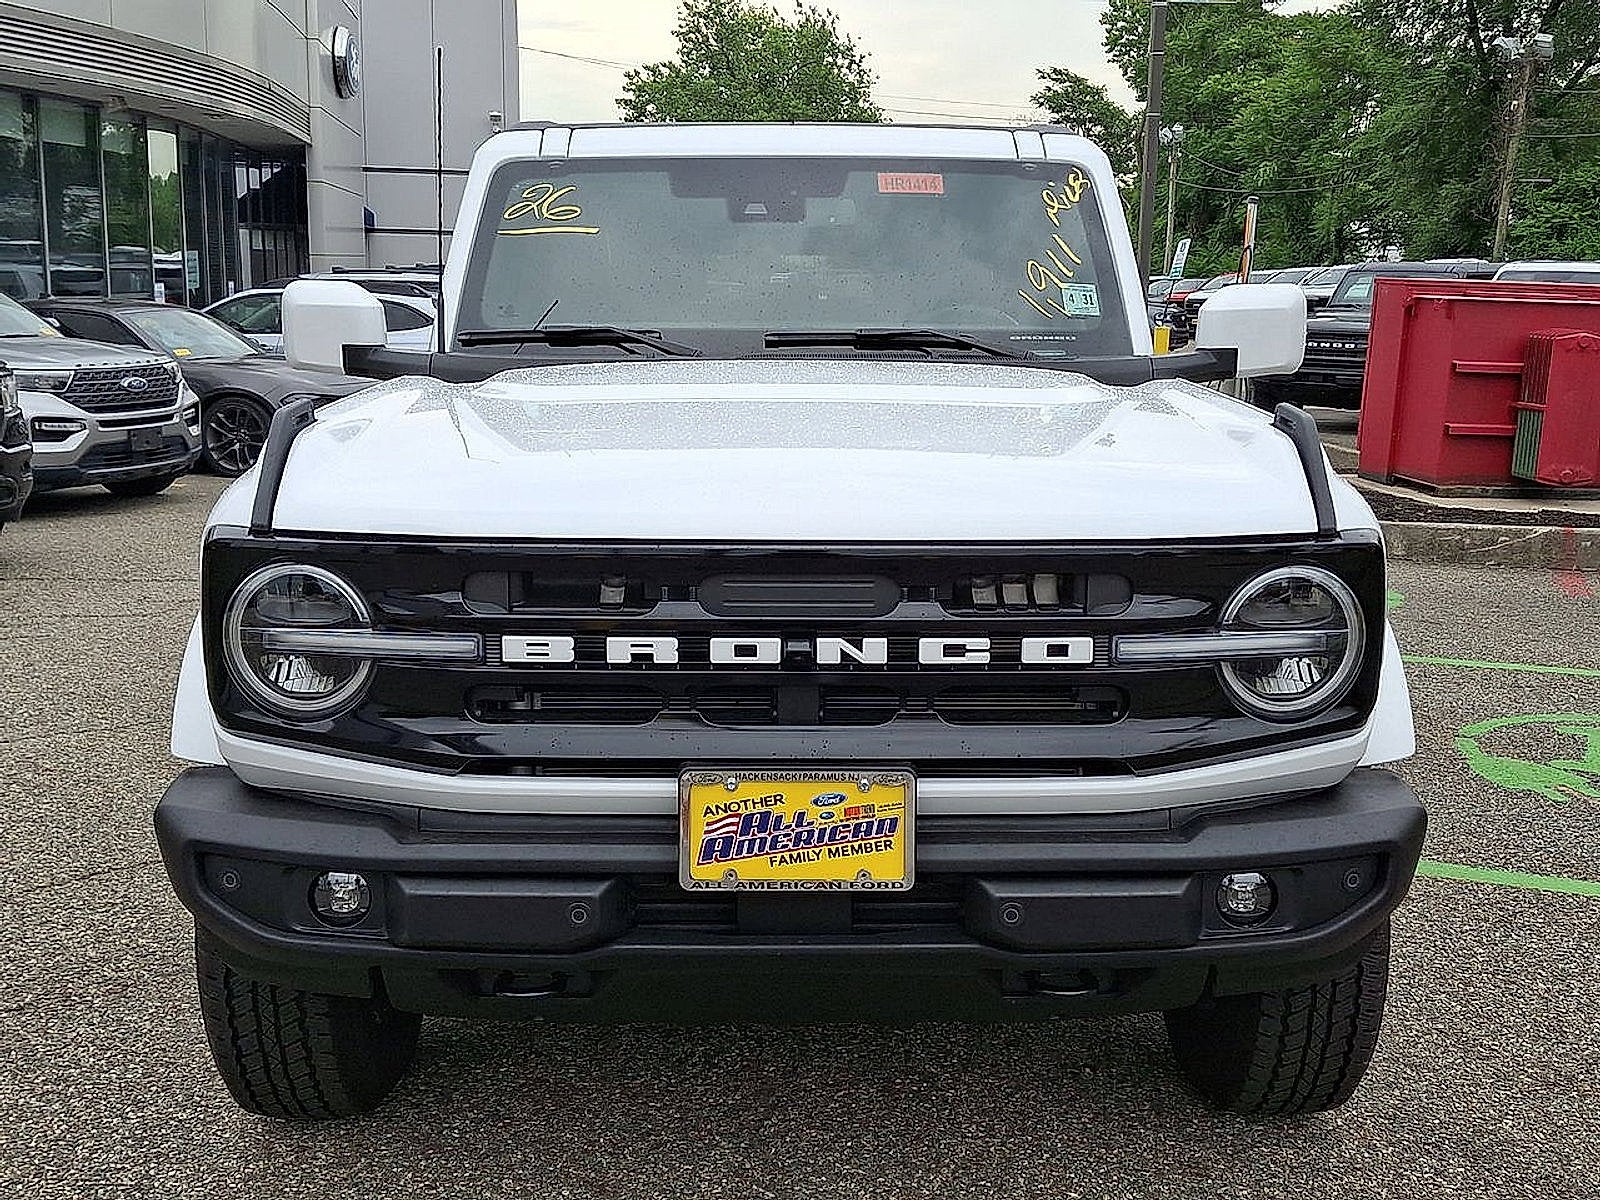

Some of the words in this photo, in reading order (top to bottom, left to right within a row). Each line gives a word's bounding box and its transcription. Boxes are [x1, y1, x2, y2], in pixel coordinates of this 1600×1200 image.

[503, 182, 582, 222] 26
[1082, 293, 1094, 305] 31
[502, 635, 1094, 664] BRONCO
[848, 772, 861, 781] NJ
[702, 793, 786, 818] ANOTHER
[768, 848, 823, 868] FAMILY
[827, 839, 894, 859] MEMBER
[690, 881, 728, 890] ALL
[734, 881, 841, 890] AMERICAN
[849, 881, 904, 890] FORD
